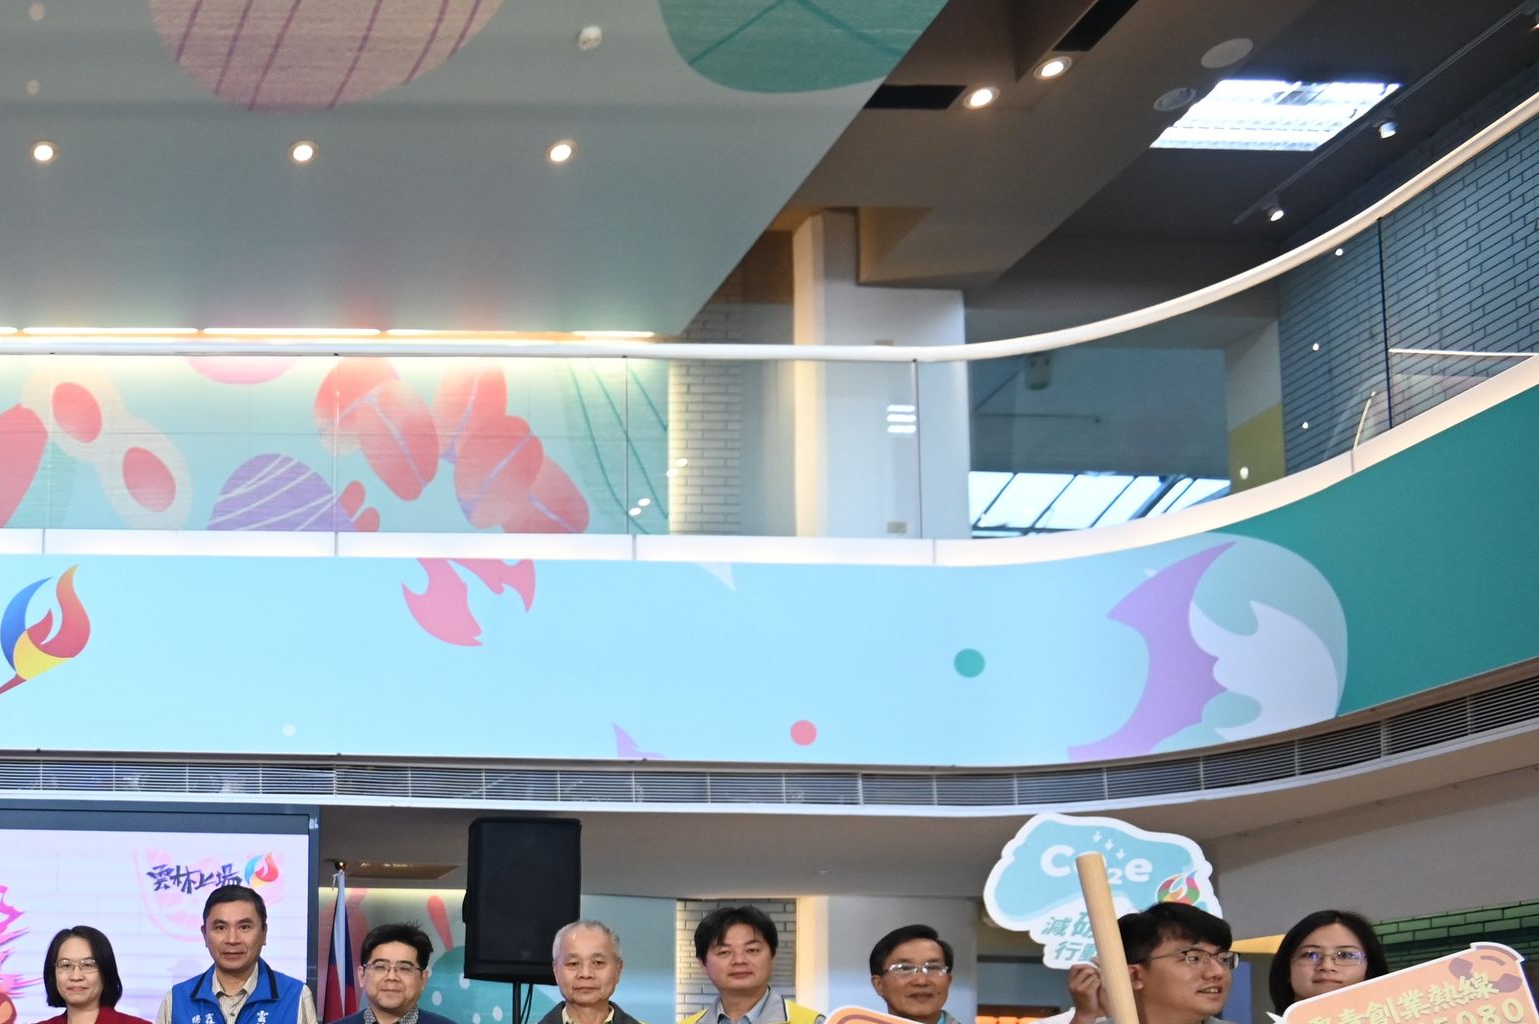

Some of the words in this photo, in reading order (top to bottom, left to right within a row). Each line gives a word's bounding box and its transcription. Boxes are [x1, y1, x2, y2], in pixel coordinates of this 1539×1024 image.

[146, 863, 242, 894] 雲林上場
[1040, 845, 1153, 885] C2e
